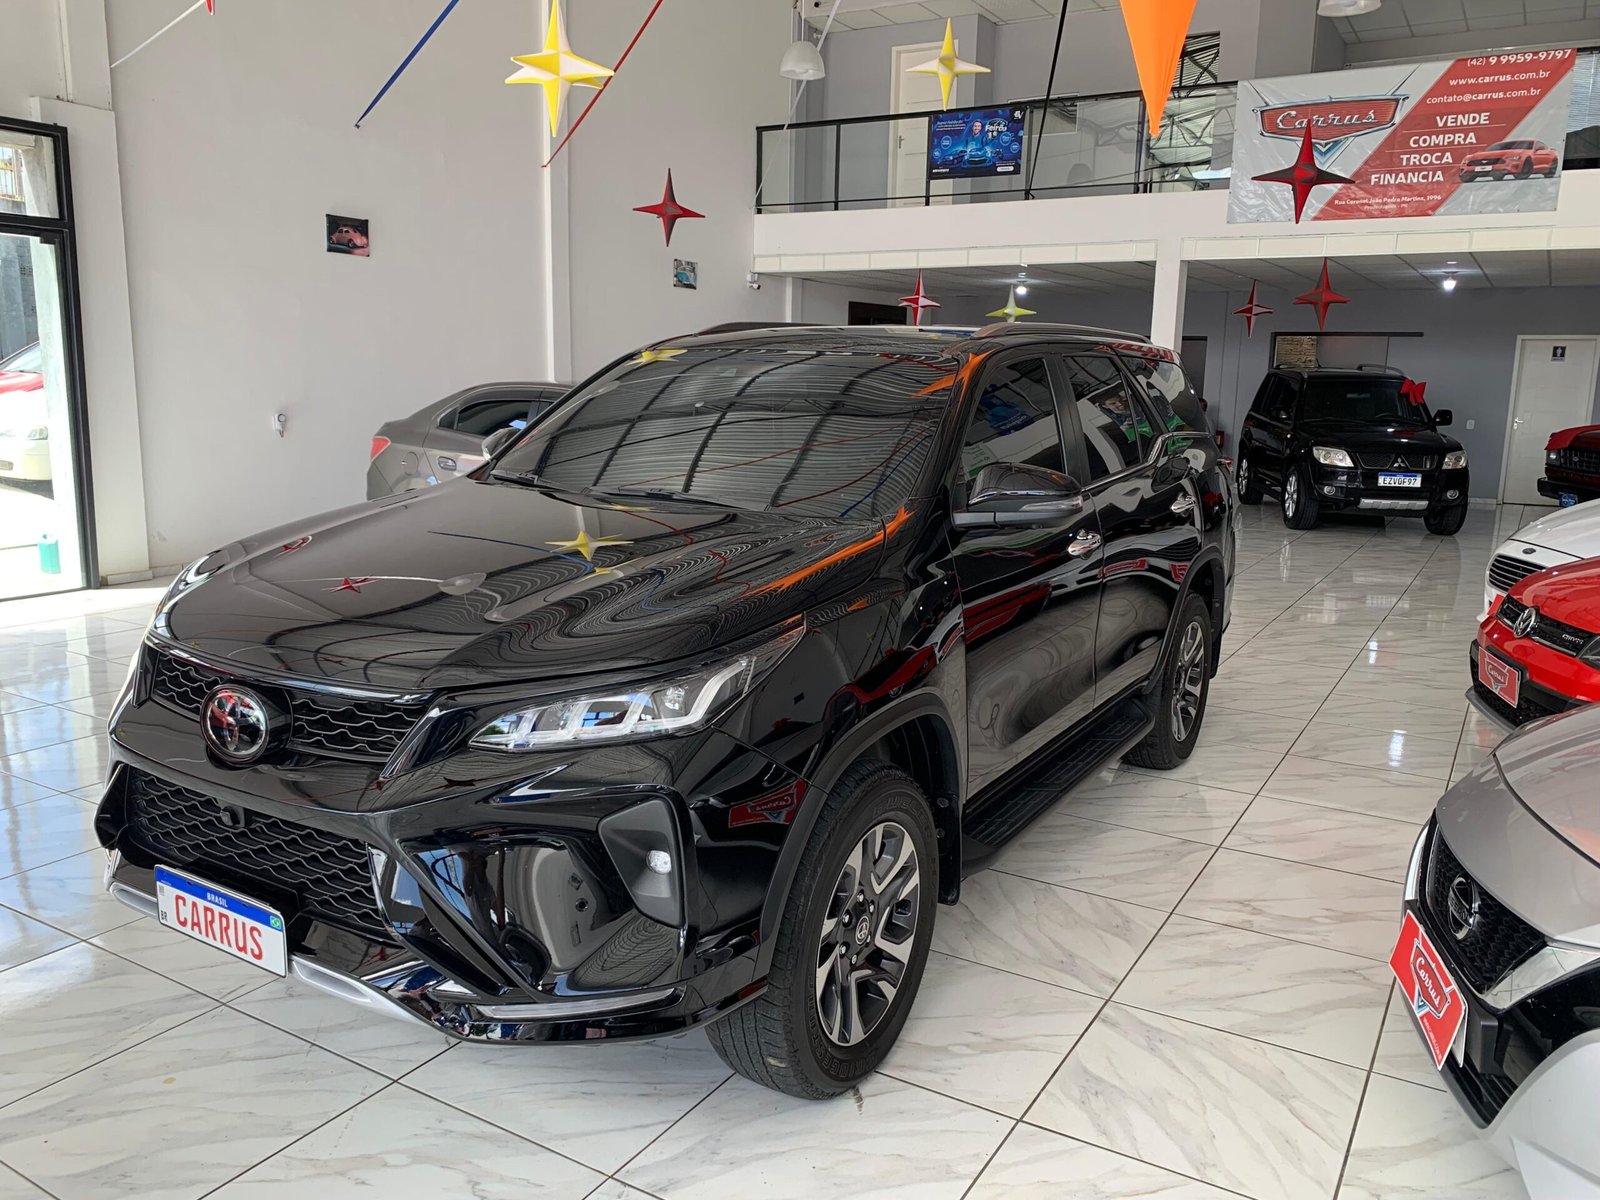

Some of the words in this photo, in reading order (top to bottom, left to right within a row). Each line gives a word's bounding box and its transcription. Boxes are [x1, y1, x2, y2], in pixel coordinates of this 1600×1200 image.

[1467, 58, 1486, 67] (42)
[1489, 56, 1498, 65] 9
[1500, 49, 1572, 65] 9959-9797
[1449, 69, 1550, 86] www.carrus.com.br
[1426, 88, 1541, 104] contato@carrus.com.br
[1276, 109, 1378, 129] Carrus
[1436, 112, 1490, 127] VENDE
[1409, 132, 1477, 148] COMPRA
[1400, 152, 1453, 166] TROCA
[1370, 170, 1444, 186] FINANCIA
[206, 892, 228, 908] BRASIL
[175, 894, 263, 961] CARRUS
[1416, 957, 1441, 1008] Carrus
